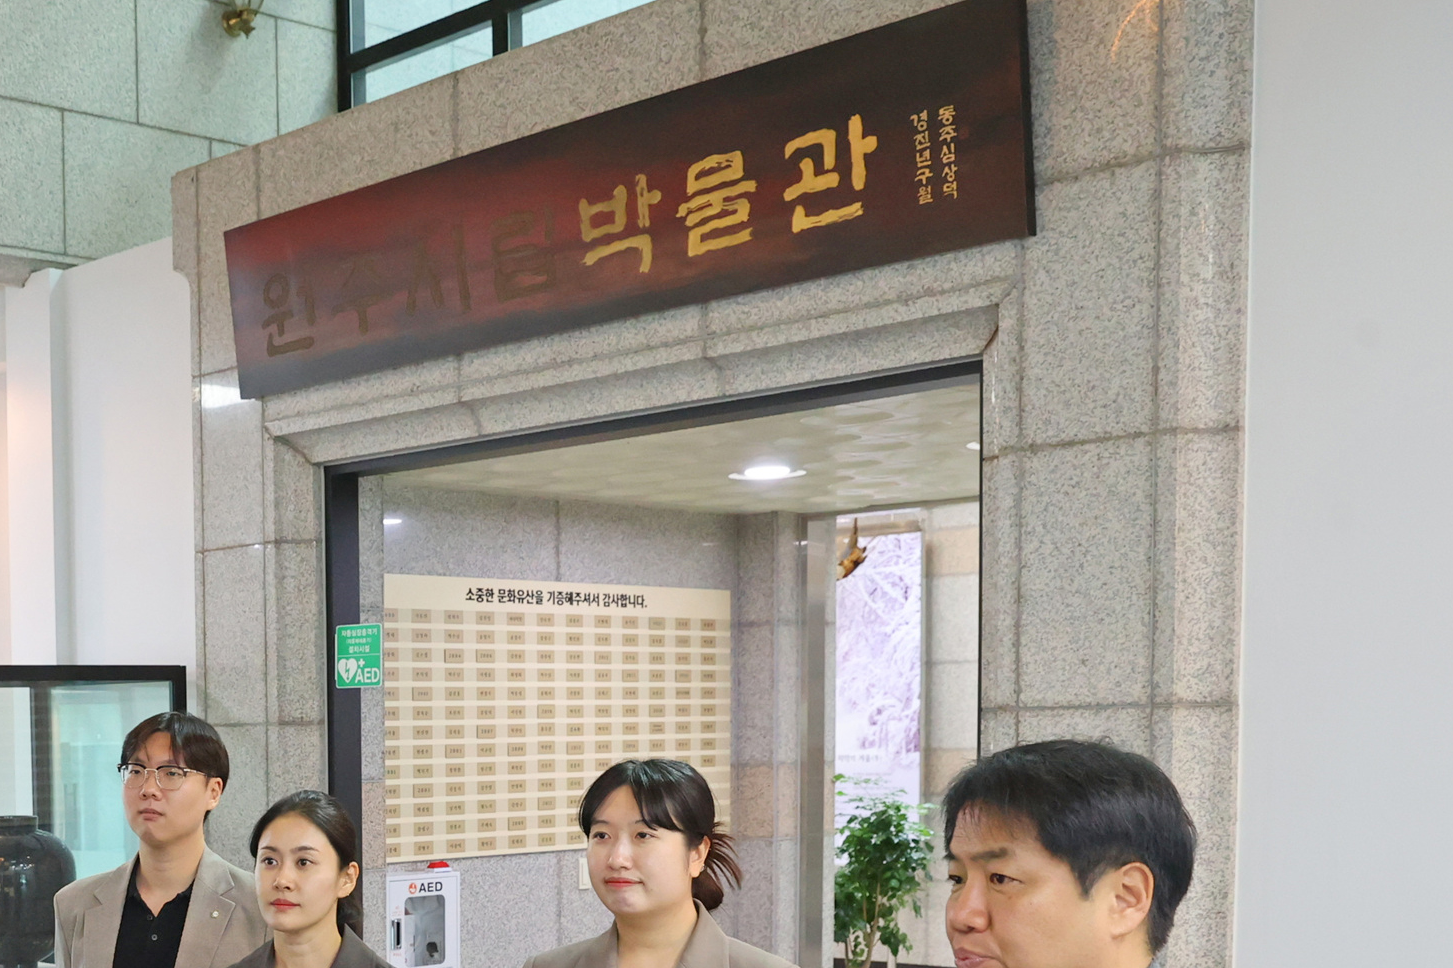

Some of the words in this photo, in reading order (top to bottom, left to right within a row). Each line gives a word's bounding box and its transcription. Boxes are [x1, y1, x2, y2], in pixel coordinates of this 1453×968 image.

[910, 109, 934, 205] 경진년구월
[938, 104, 958, 199] 동주심상덕
[465, 587, 495, 603] 소중한
[497, 588, 544, 605] 문화유산을
[546, 590, 600, 607] 기증해주셔서
[602, 593, 648, 608] 감사합니다.
[349, 645, 370, 653] 설치시설
[355, 667, 380, 683] AED
[418, 881, 443, 893] AED
